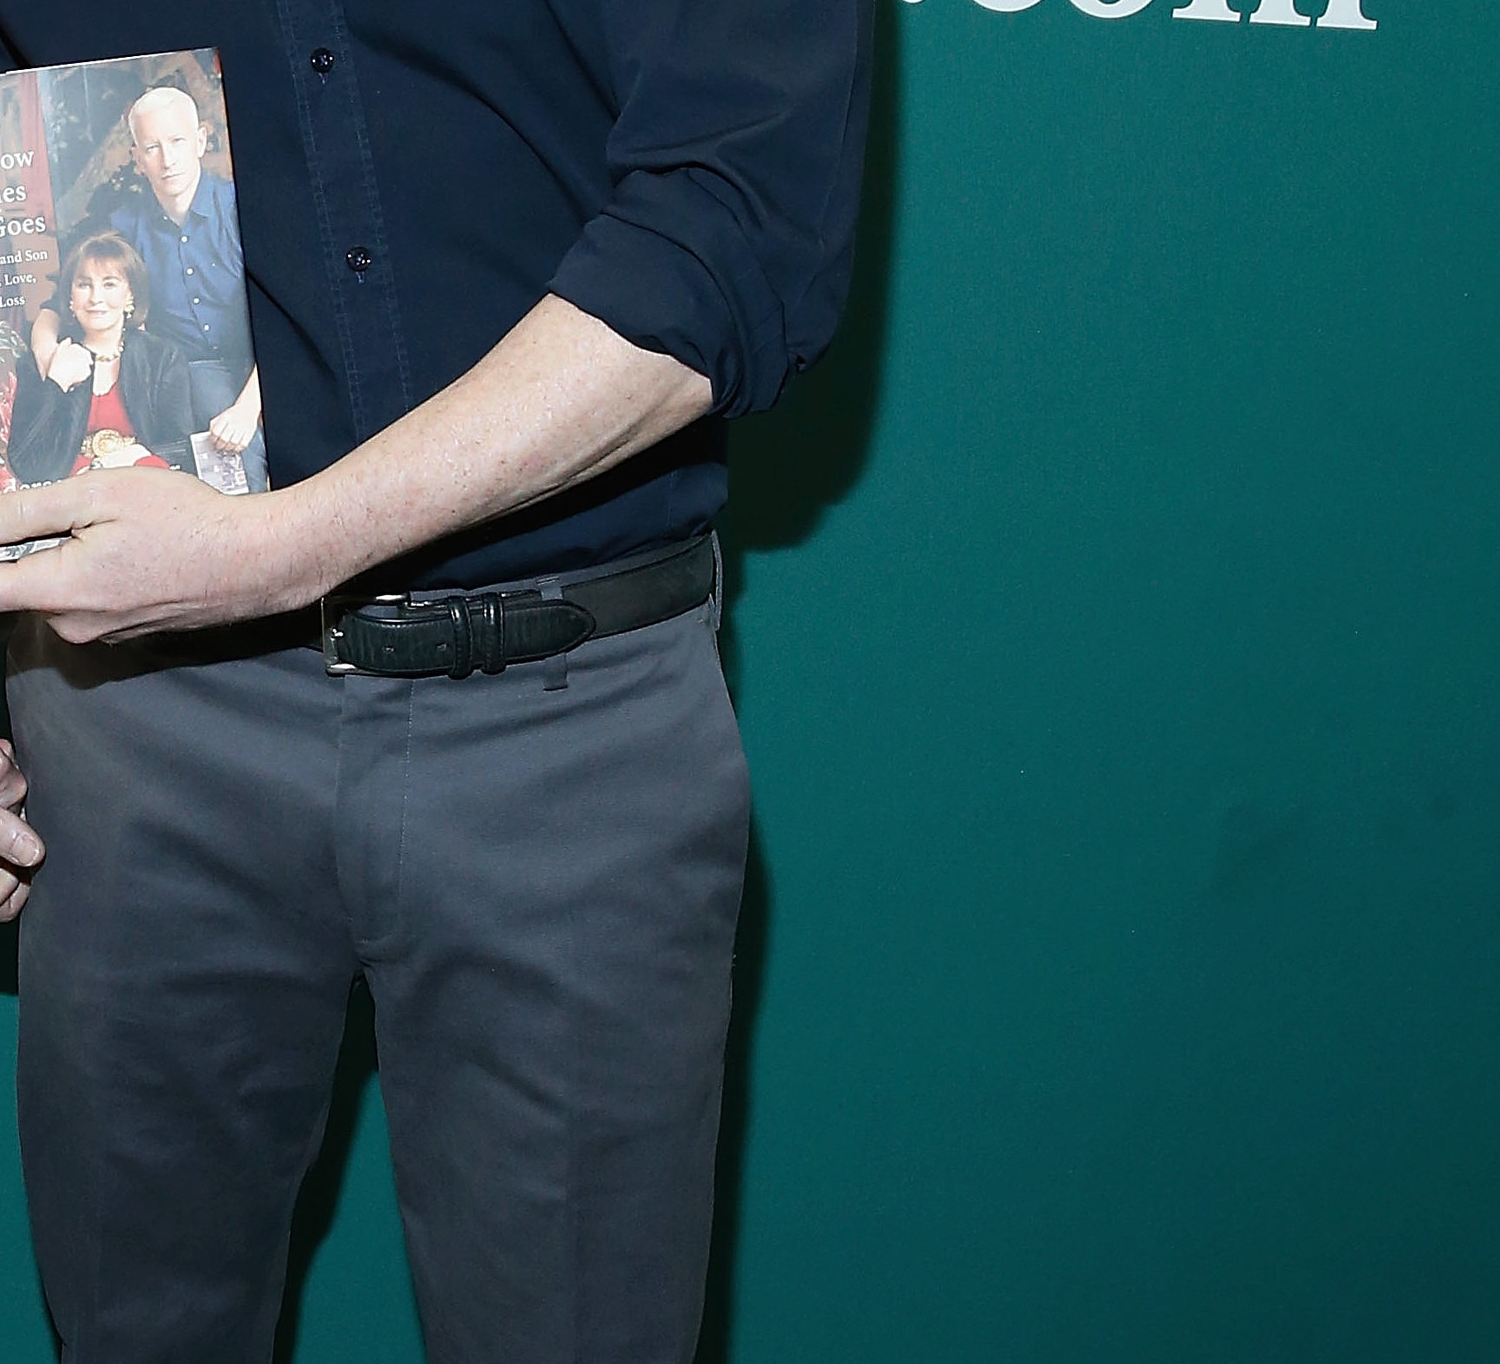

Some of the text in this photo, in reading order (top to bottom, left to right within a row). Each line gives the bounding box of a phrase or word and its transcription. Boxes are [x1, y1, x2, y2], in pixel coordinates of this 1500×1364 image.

[0, 250, 23, 265] and
[25, 250, 48, 262] Son
[4, 273, 37, 286] Love,
